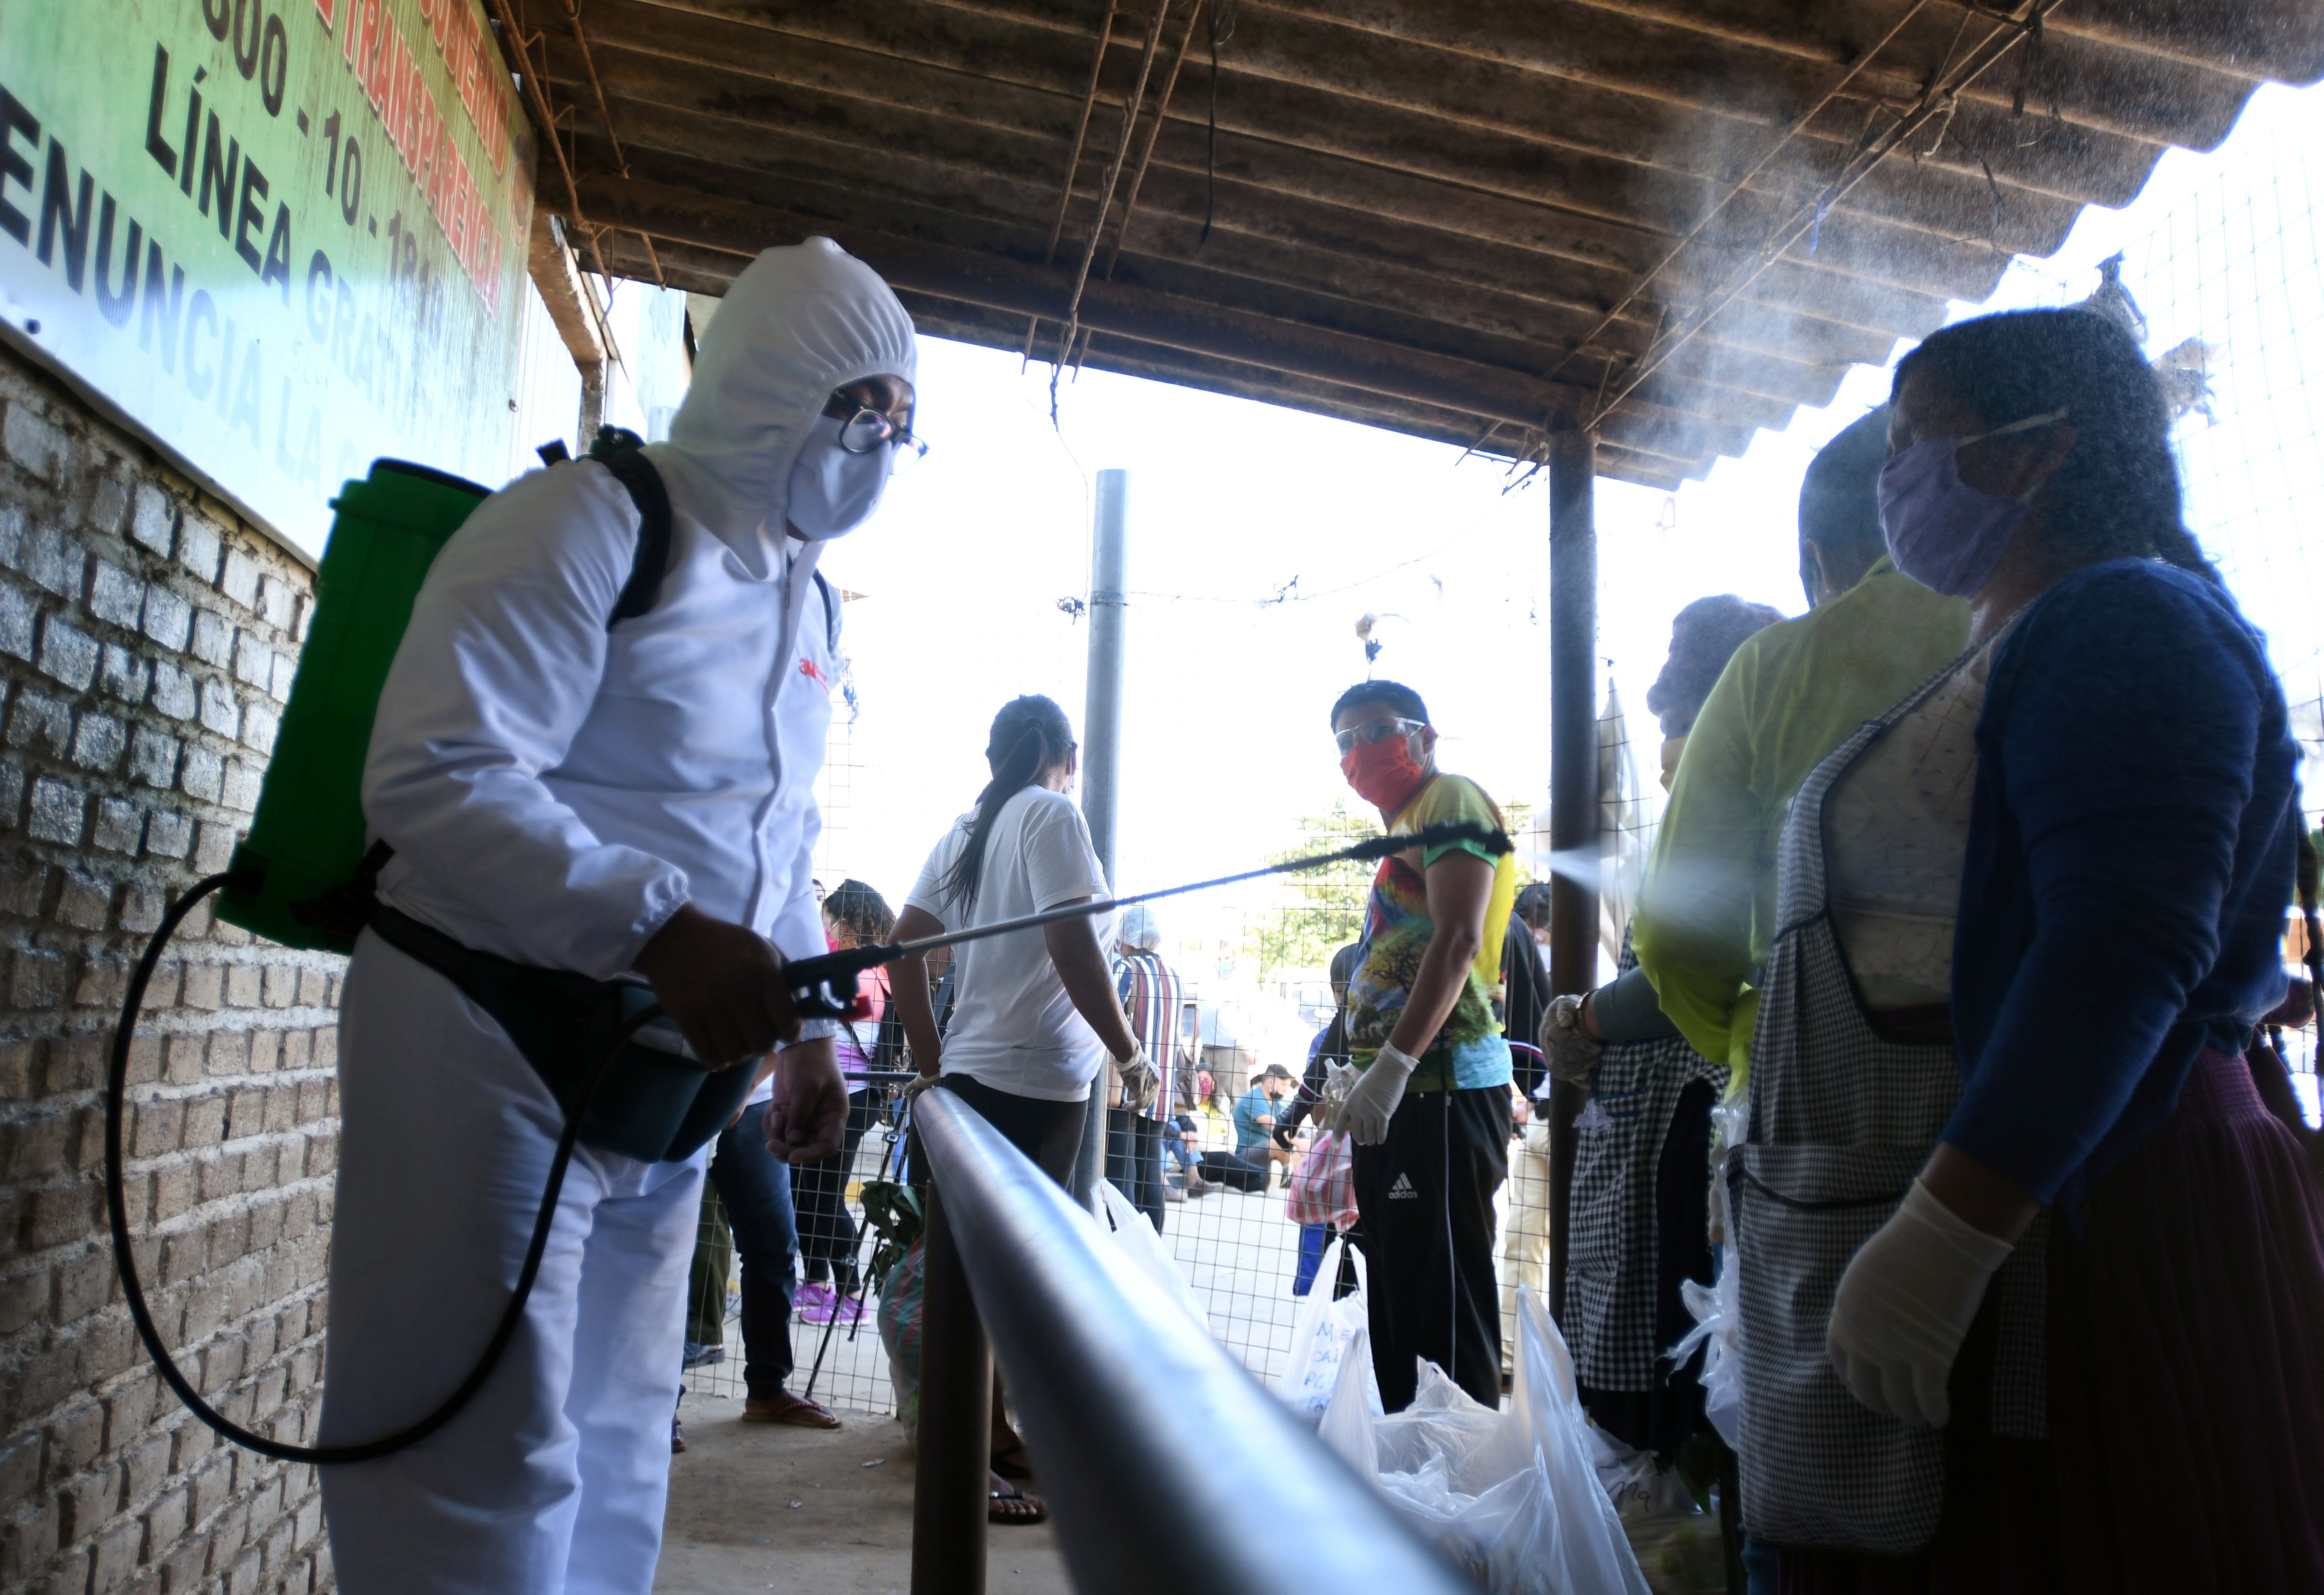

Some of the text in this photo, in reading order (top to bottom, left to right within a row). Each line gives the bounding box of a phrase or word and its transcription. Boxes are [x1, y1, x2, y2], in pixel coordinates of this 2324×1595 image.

[419, 0, 507, 176] OBIERNO
[145, 40, 291, 309] LÍNEA
[799, 658, 817, 680] 3M
[1388, 1190, 1418, 1199] adidas
